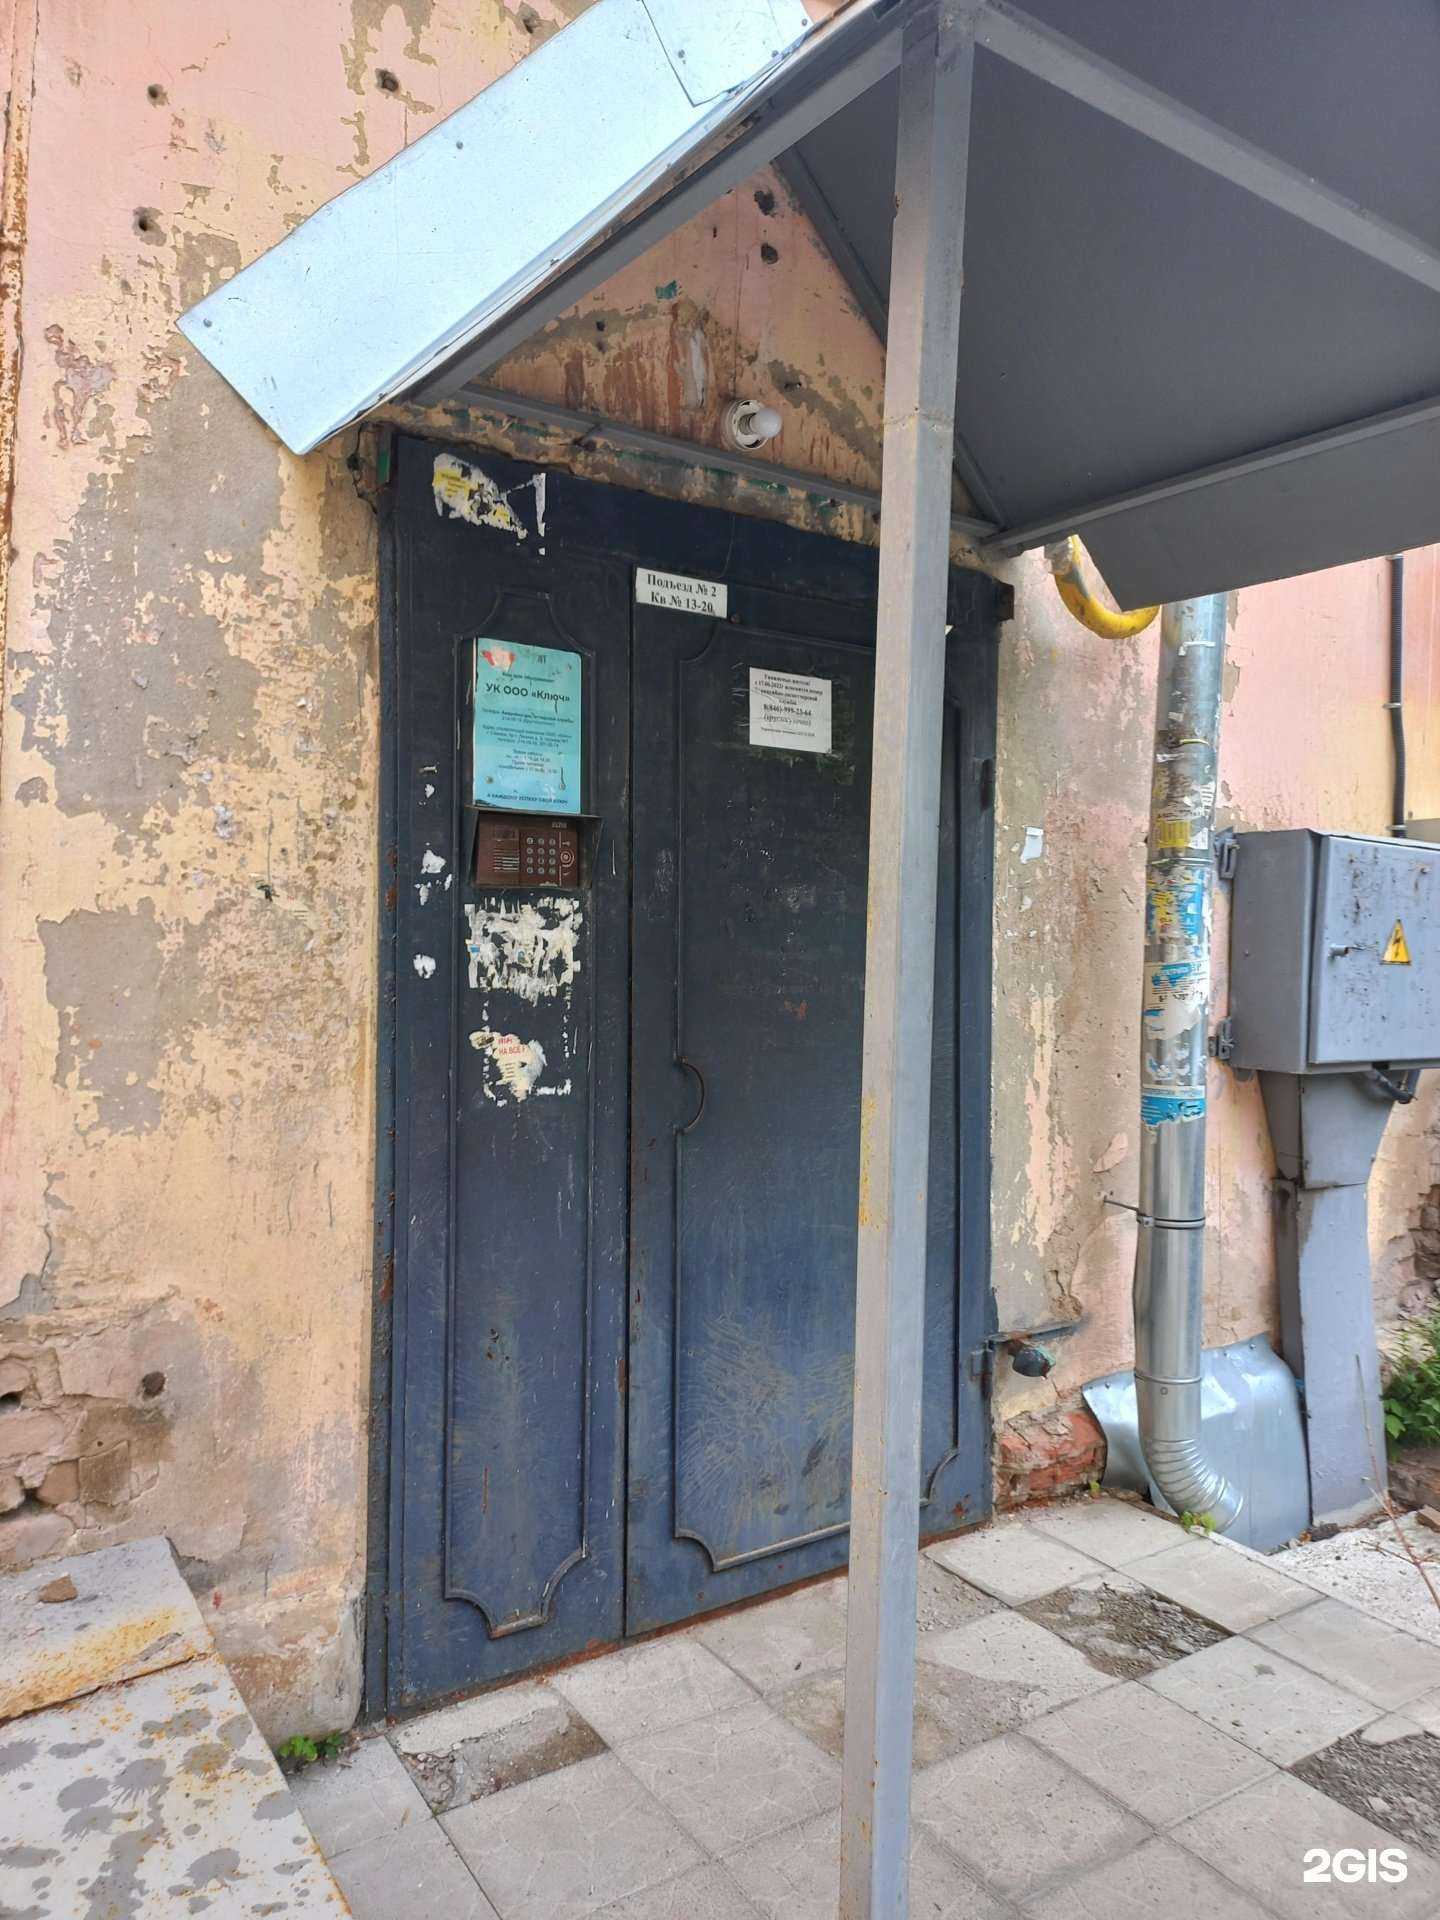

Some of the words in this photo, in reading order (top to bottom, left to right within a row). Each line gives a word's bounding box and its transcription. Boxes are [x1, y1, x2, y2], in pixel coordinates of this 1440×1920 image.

[647, 573, 693, 594] Подъезд
[695, 583, 709, 596] №
[711, 586, 717, 597] 2
[651, 591, 666, 604] Кв
[669, 595, 682, 608] №
[685, 598, 713, 613] 13-20
[486, 682, 501, 694] УК
[503, 685, 529, 697] ООО
[531, 690, 570, 703] «Ключ»
